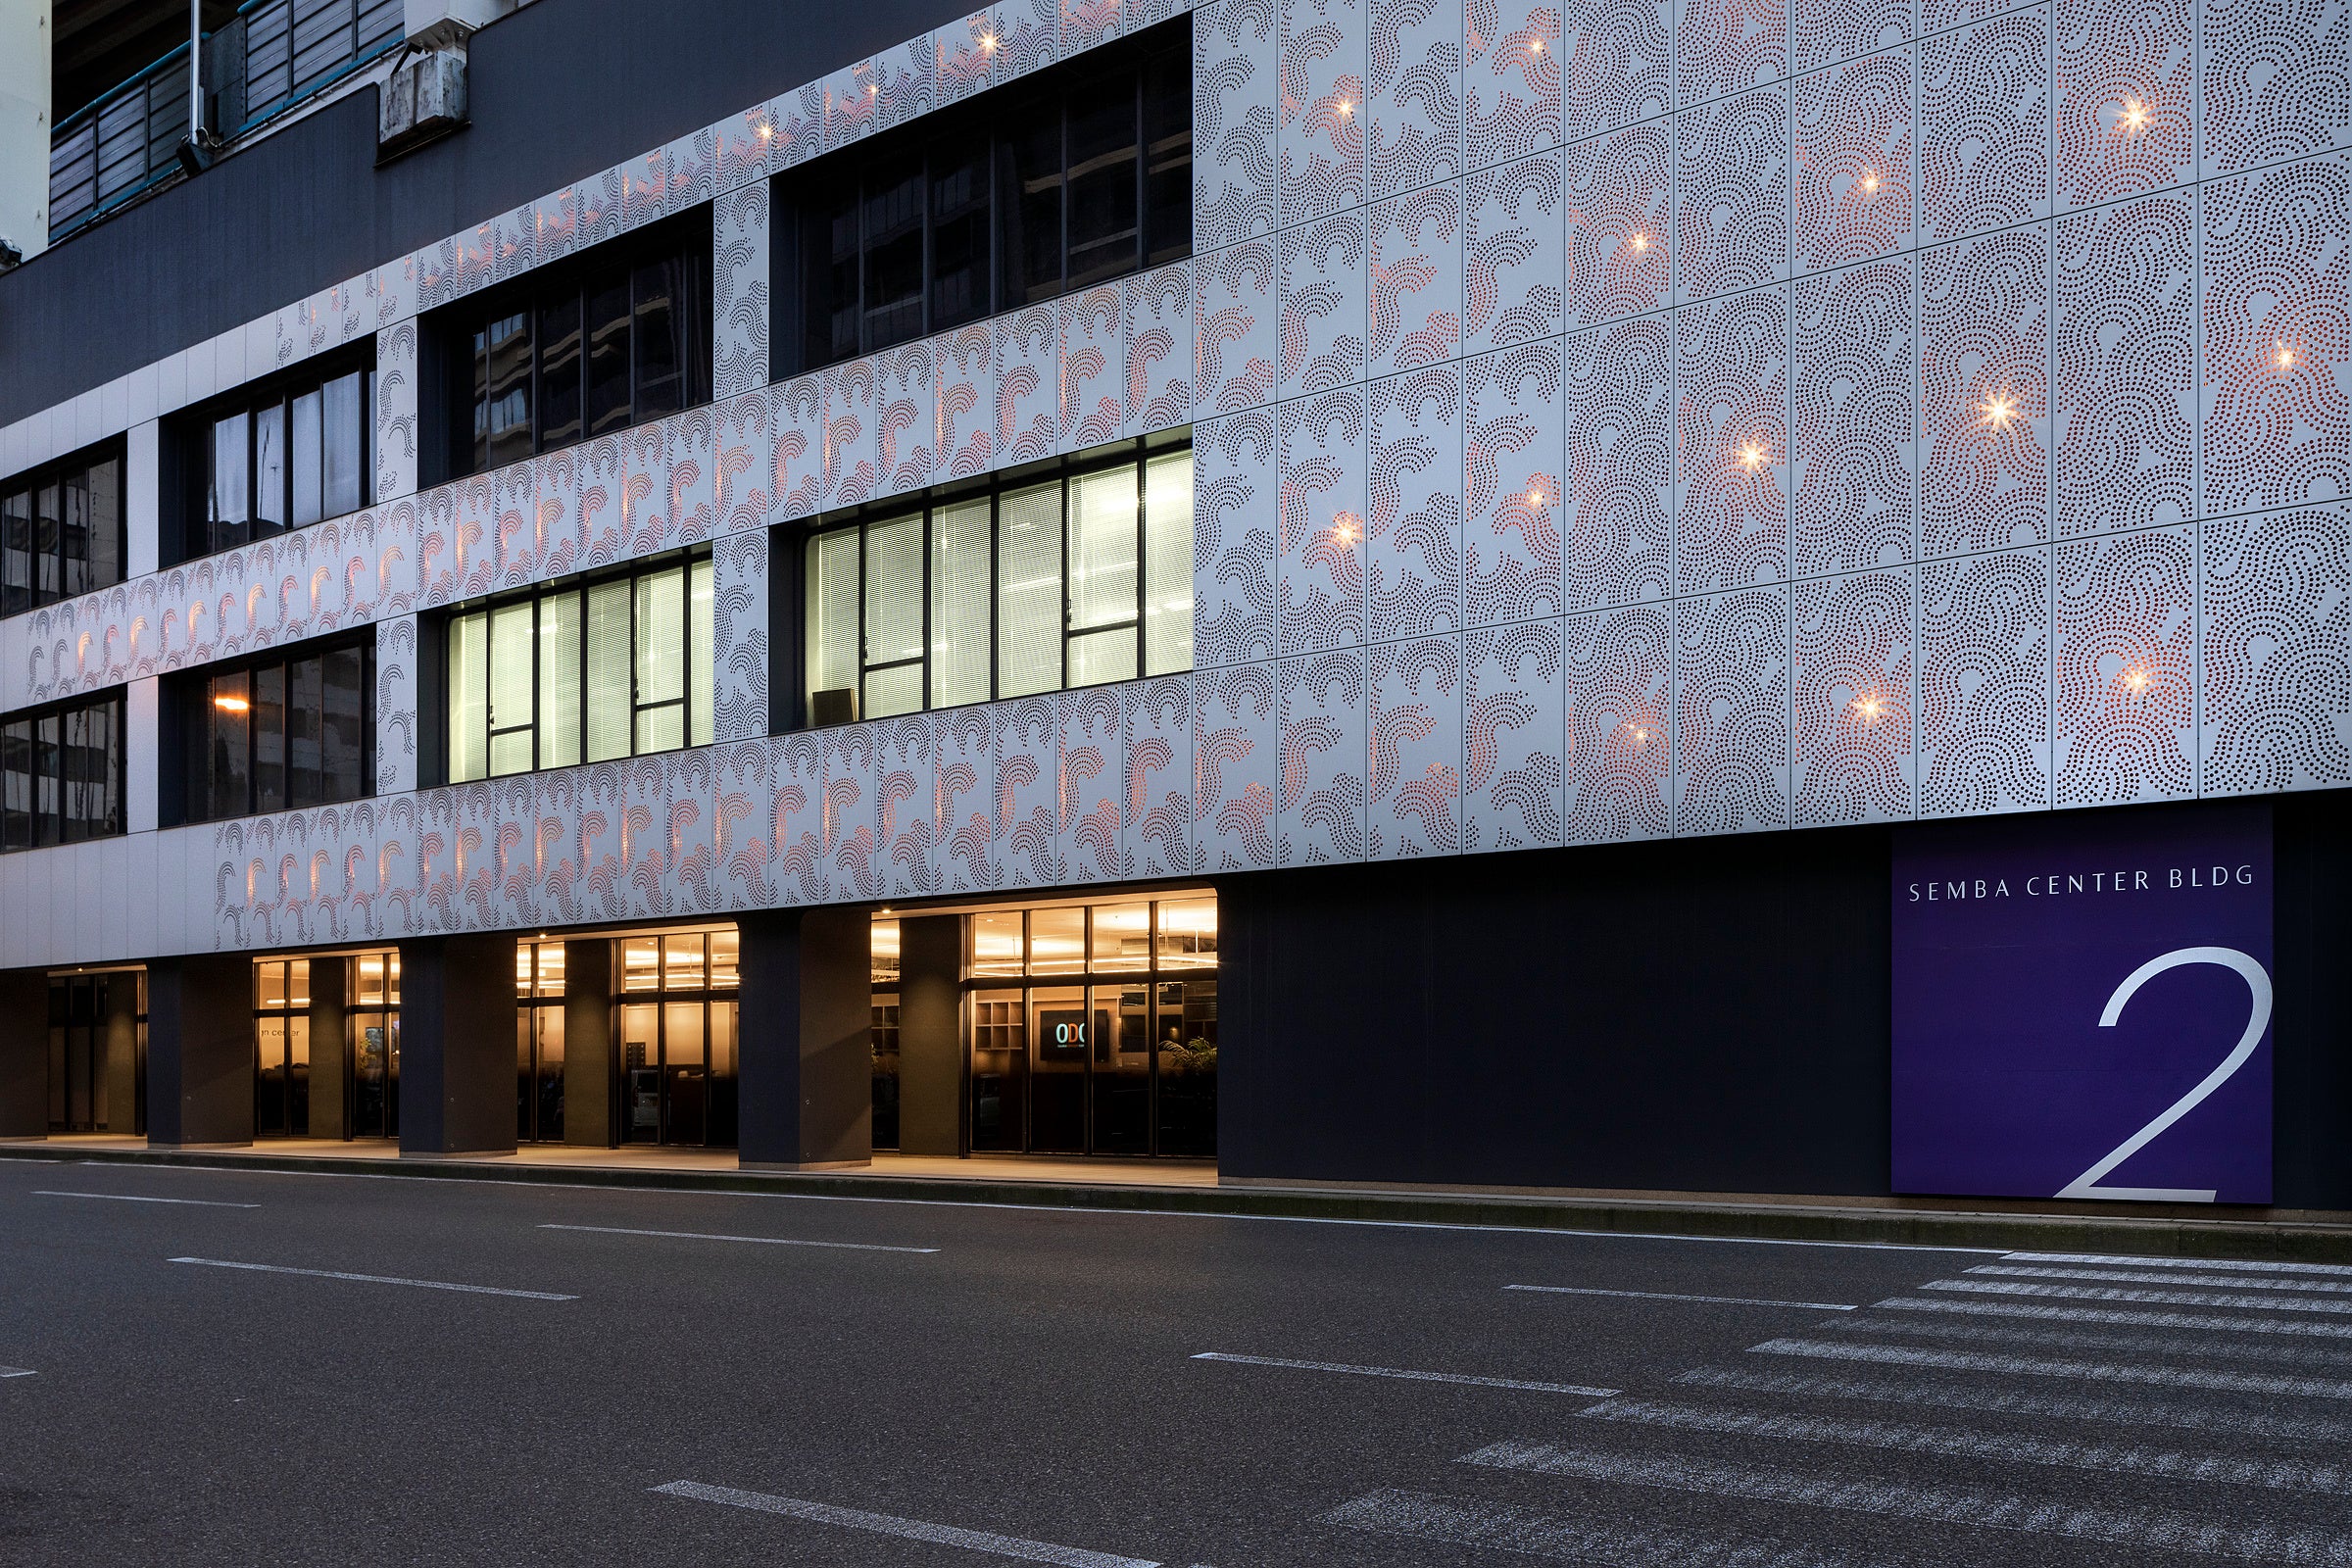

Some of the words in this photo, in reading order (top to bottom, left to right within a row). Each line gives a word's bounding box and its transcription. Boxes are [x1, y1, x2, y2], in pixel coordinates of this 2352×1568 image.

[1908, 878, 2010, 902] SEMBA
[2027, 870, 2149, 896] CENTER
[2170, 864, 2253, 889] BLDG
[2053, 946, 2274, 1203] 2
